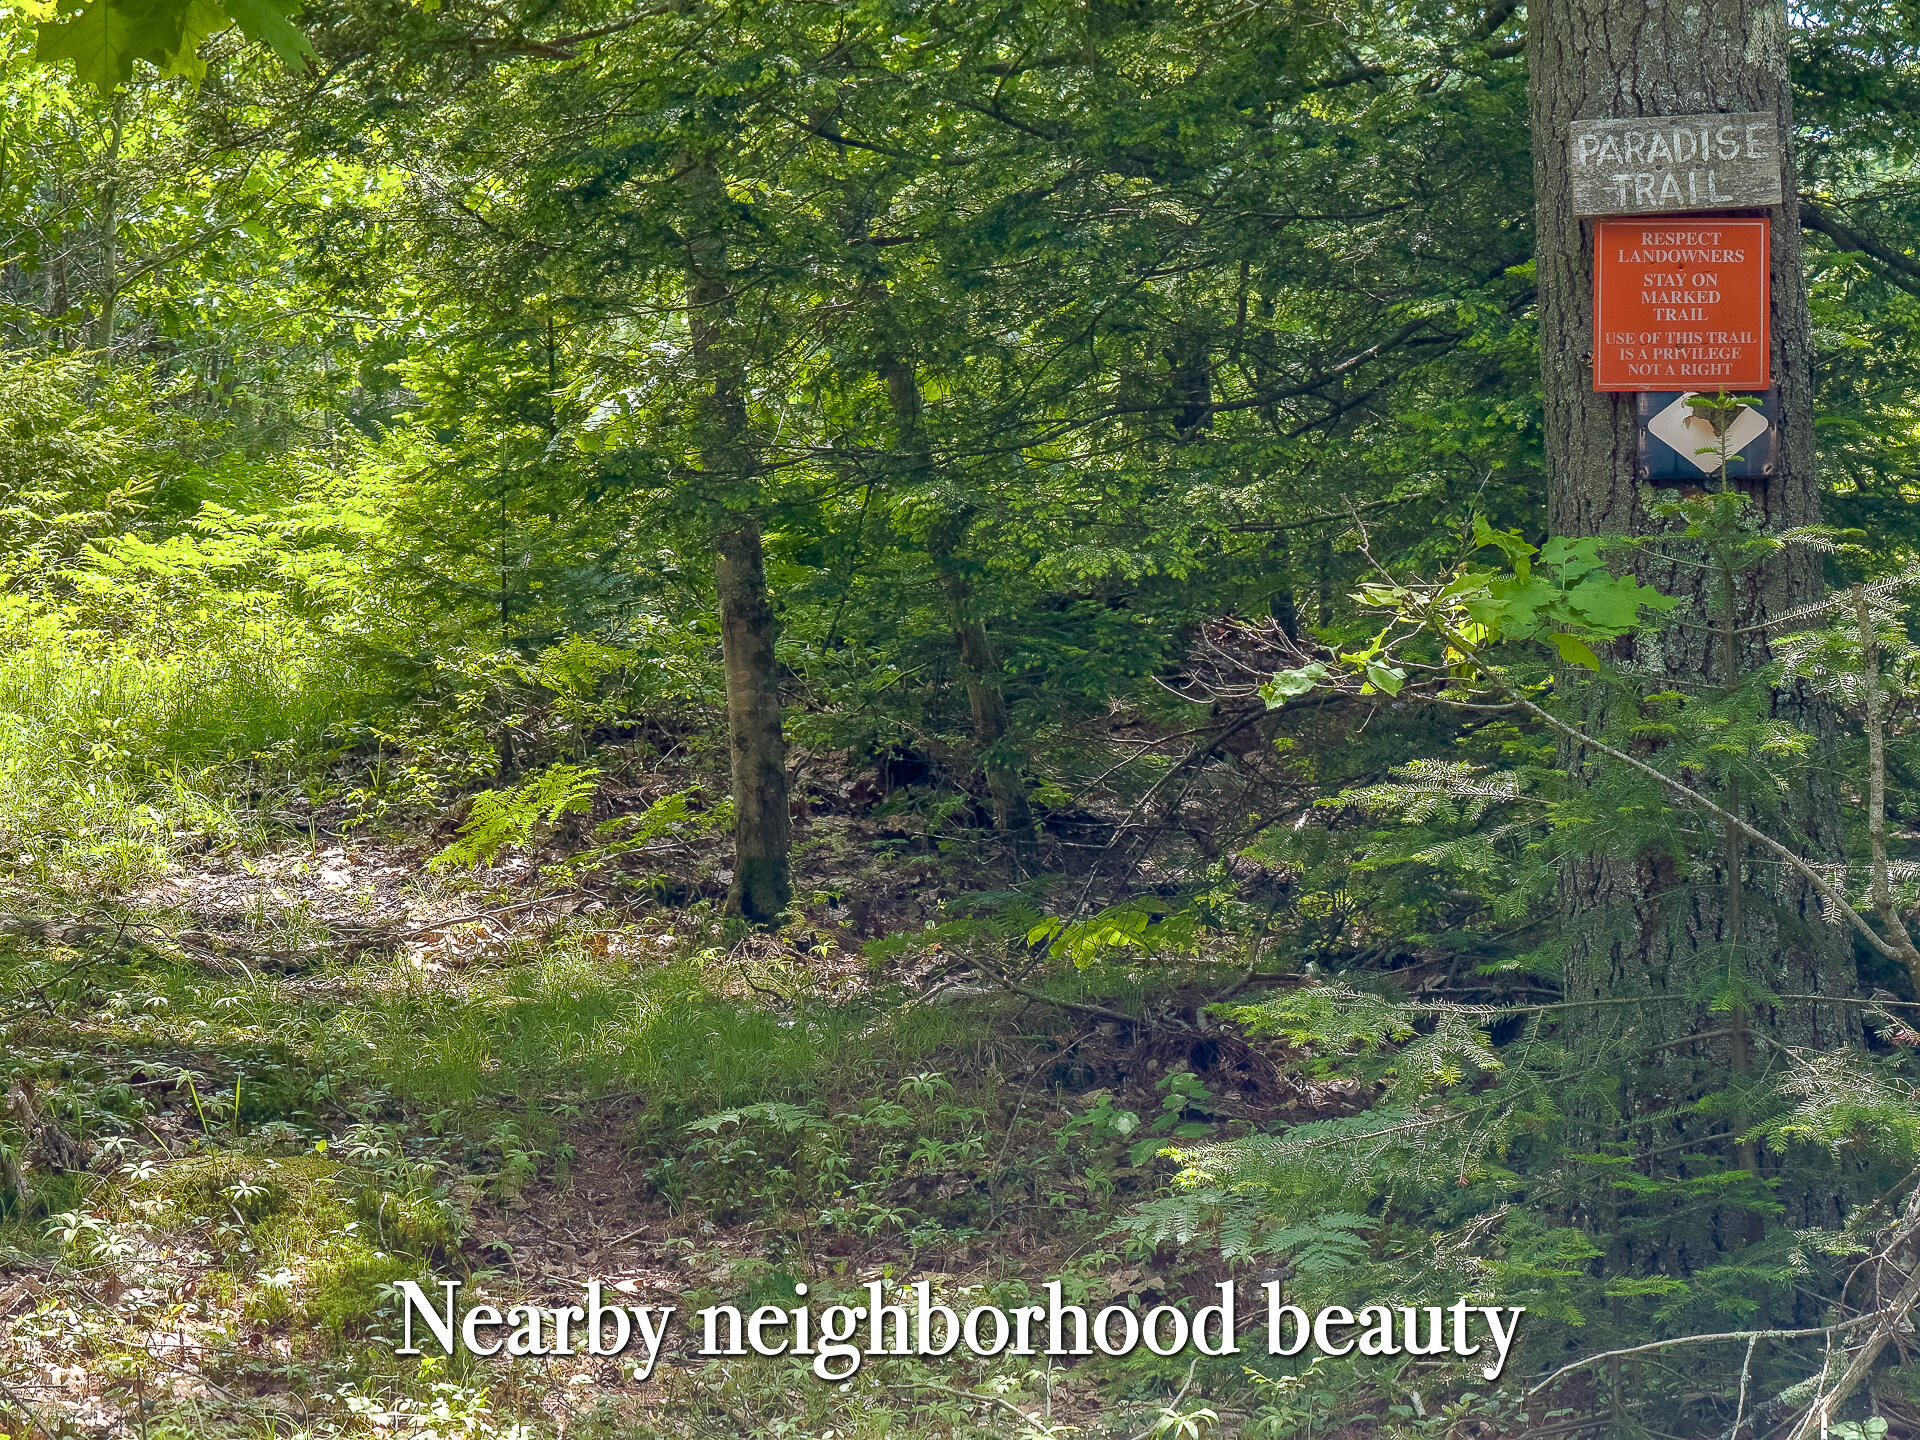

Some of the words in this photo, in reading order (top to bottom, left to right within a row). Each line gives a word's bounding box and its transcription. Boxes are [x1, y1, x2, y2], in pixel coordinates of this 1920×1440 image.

[1577, 123, 1770, 167] PARADISE
[1610, 169, 1734, 207] TRAIL
[1641, 232, 1722, 246] RESPECT
[1617, 249, 1745, 263] LANDOWNERS
[1643, 273, 1687, 287] STAY
[1691, 273, 1718, 287] ON
[1641, 290, 1721, 304] MARKED
[1653, 307, 1709, 321] TRAIL
[1605, 332, 1635, 344] USE
[1639, 332, 1662, 344] OF
[1665, 331, 1703, 344] THIS
[1706, 331, 1757, 344] TRAIL
[1619, 347, 1634, 360] IS
[1637, 347, 1649, 360] A
[1653, 347, 1742, 360] PRIVILEGE
[1627, 363, 1662, 376] NOT
[1665, 363, 1676, 376] A
[1681, 363, 1733, 376] RIGHT
